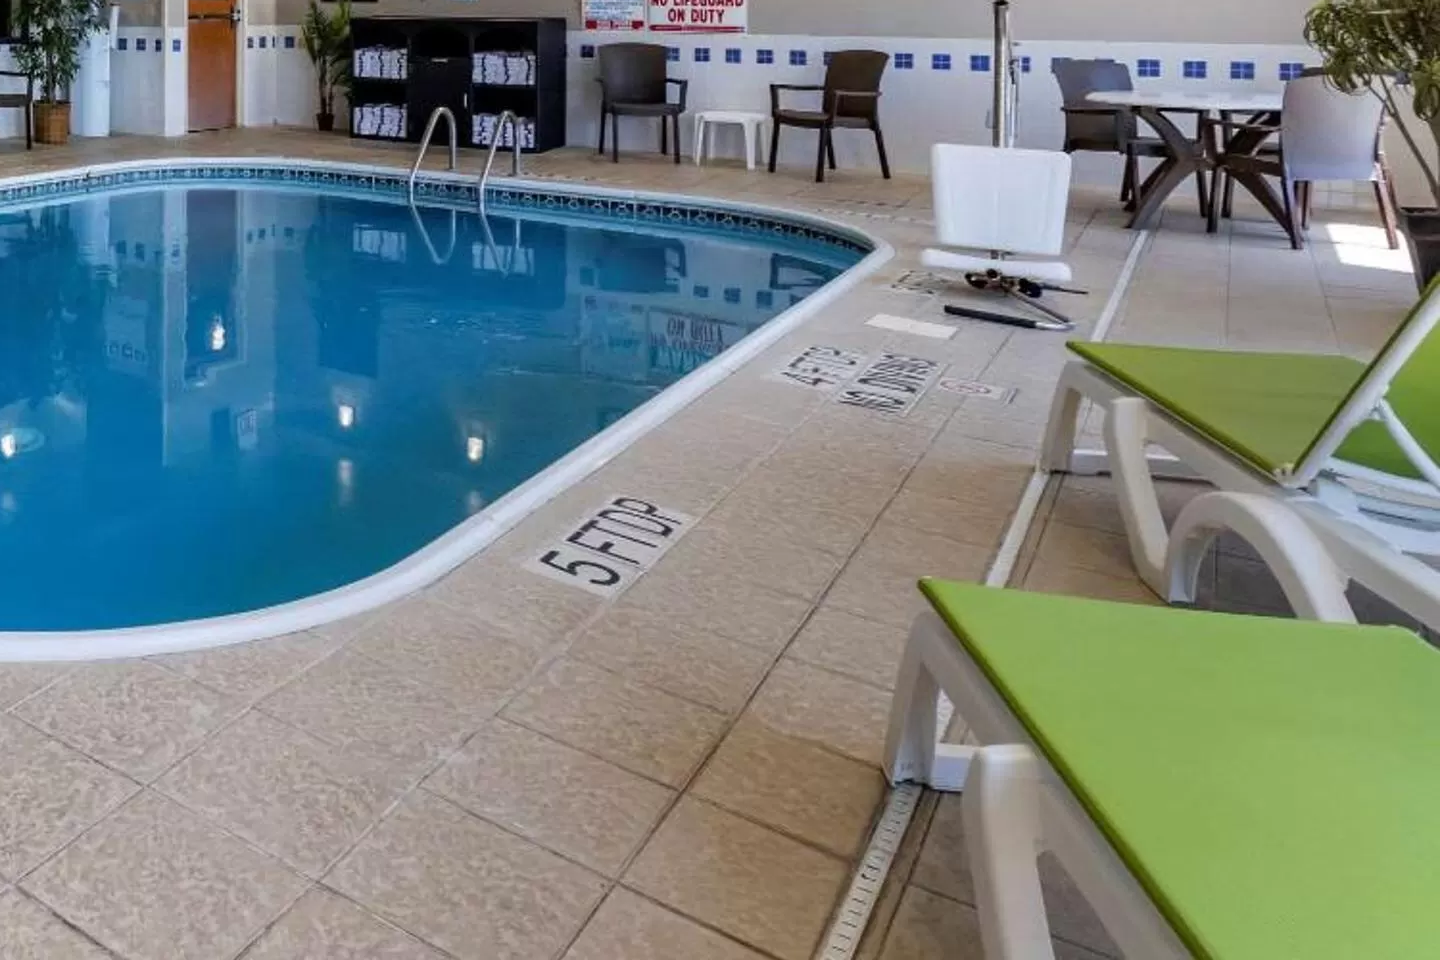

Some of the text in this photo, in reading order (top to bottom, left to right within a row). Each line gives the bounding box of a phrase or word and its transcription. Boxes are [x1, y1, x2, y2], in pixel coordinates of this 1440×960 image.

[667, 9, 725, 23] ON DUTY
[539, 550, 620, 586] 5
